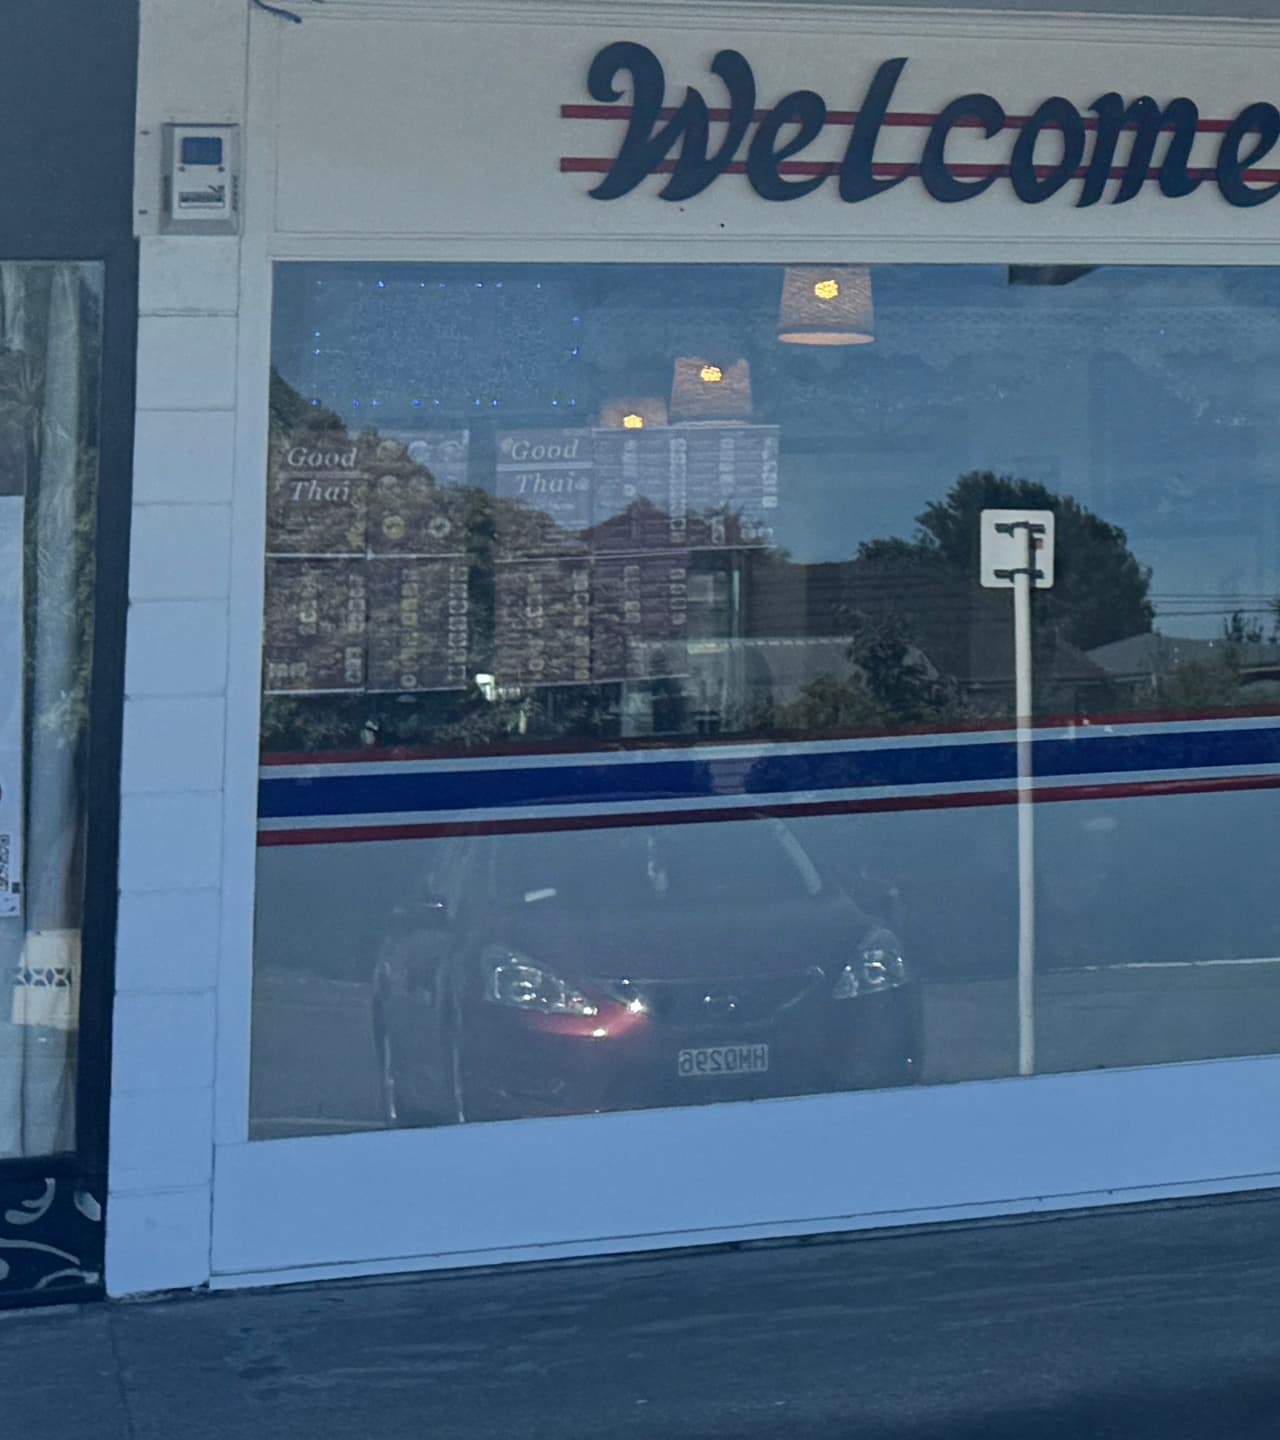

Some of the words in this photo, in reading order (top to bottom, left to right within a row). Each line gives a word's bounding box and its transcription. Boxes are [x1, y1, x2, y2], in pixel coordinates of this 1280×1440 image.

[287, 446, 358, 468] Good
[511, 438, 580, 462] Good
[290, 479, 350, 503] Thai
[515, 471, 575, 495] Thai
